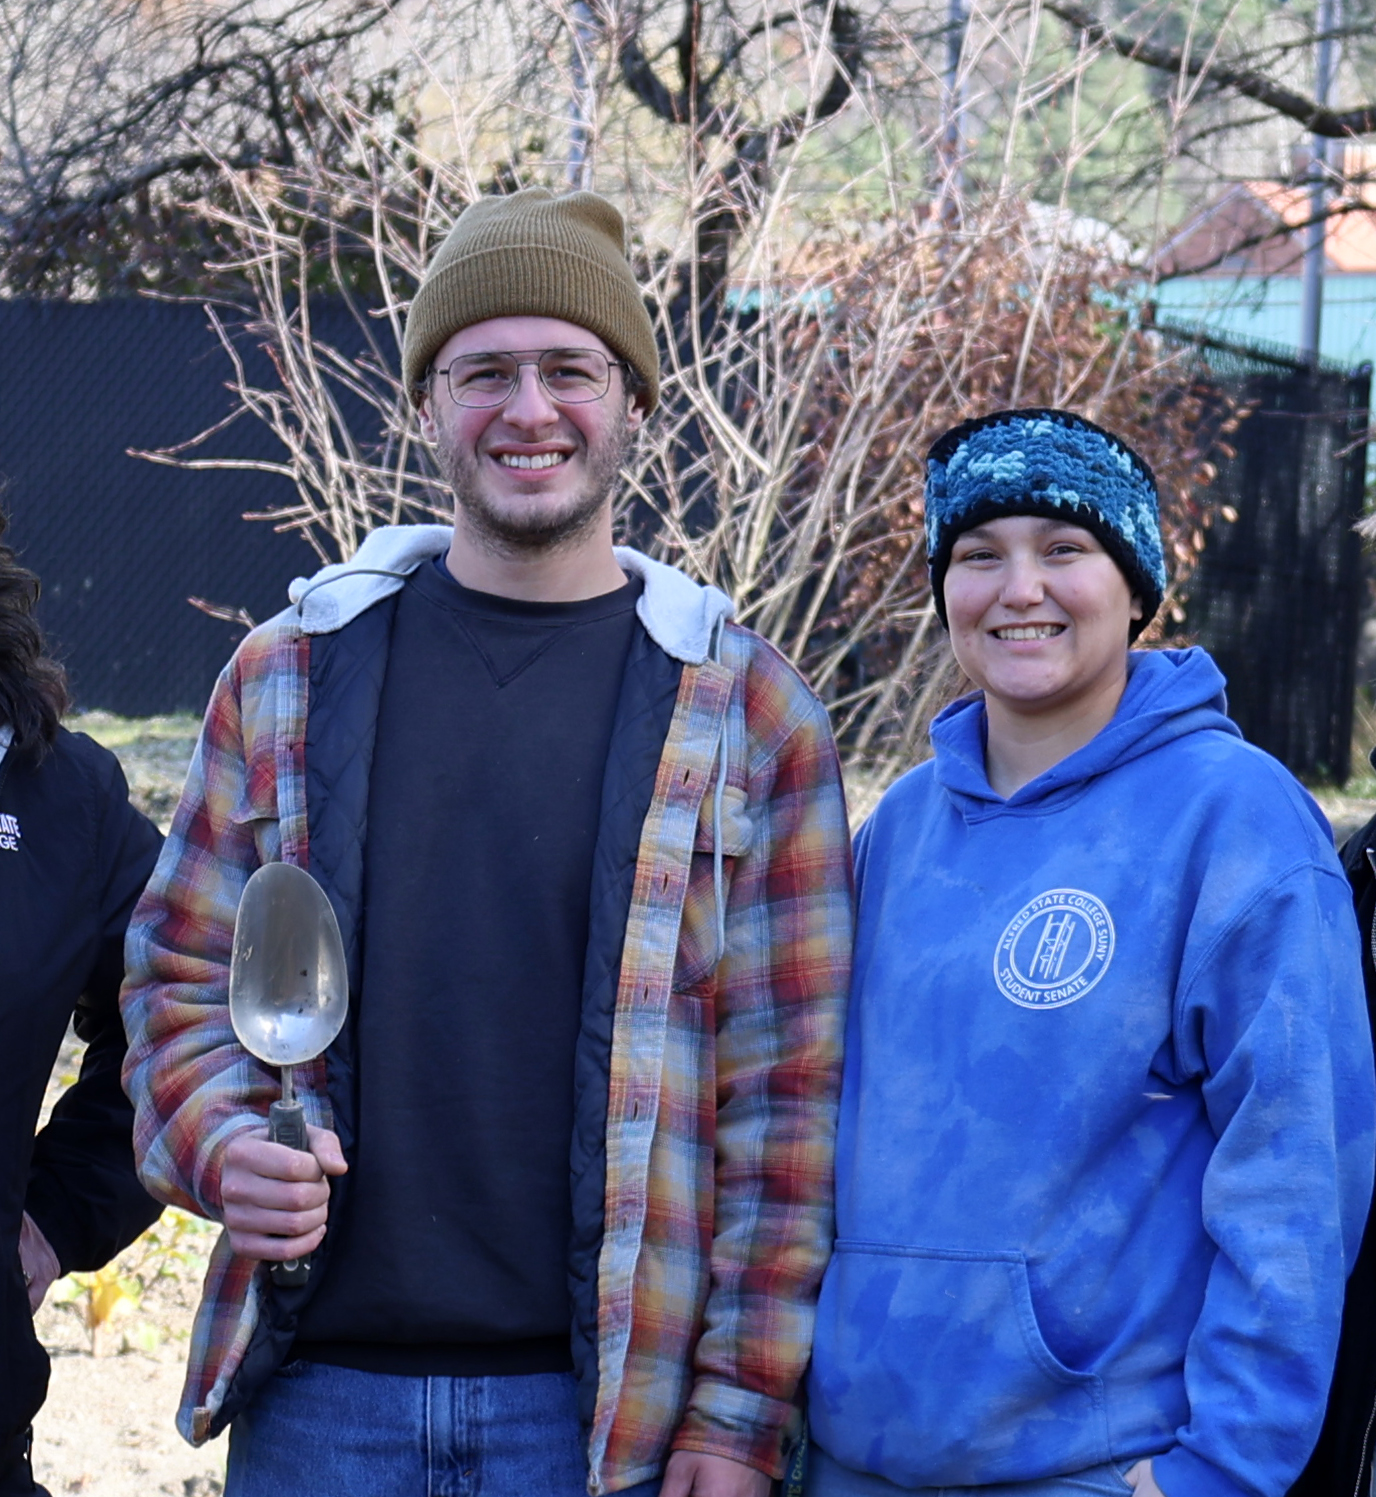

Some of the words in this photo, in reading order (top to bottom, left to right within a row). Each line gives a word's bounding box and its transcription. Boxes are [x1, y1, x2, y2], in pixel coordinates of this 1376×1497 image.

[1002, 911, 1030, 950] ALFRED
[1031, 894, 1065, 913] STATE
[1067, 895, 1106, 927] COLLEGE
[1095, 928, 1109, 962] SUNY
[1000, 967, 1041, 1002] STUDENT
[1043, 975, 1089, 1002] SENATE
